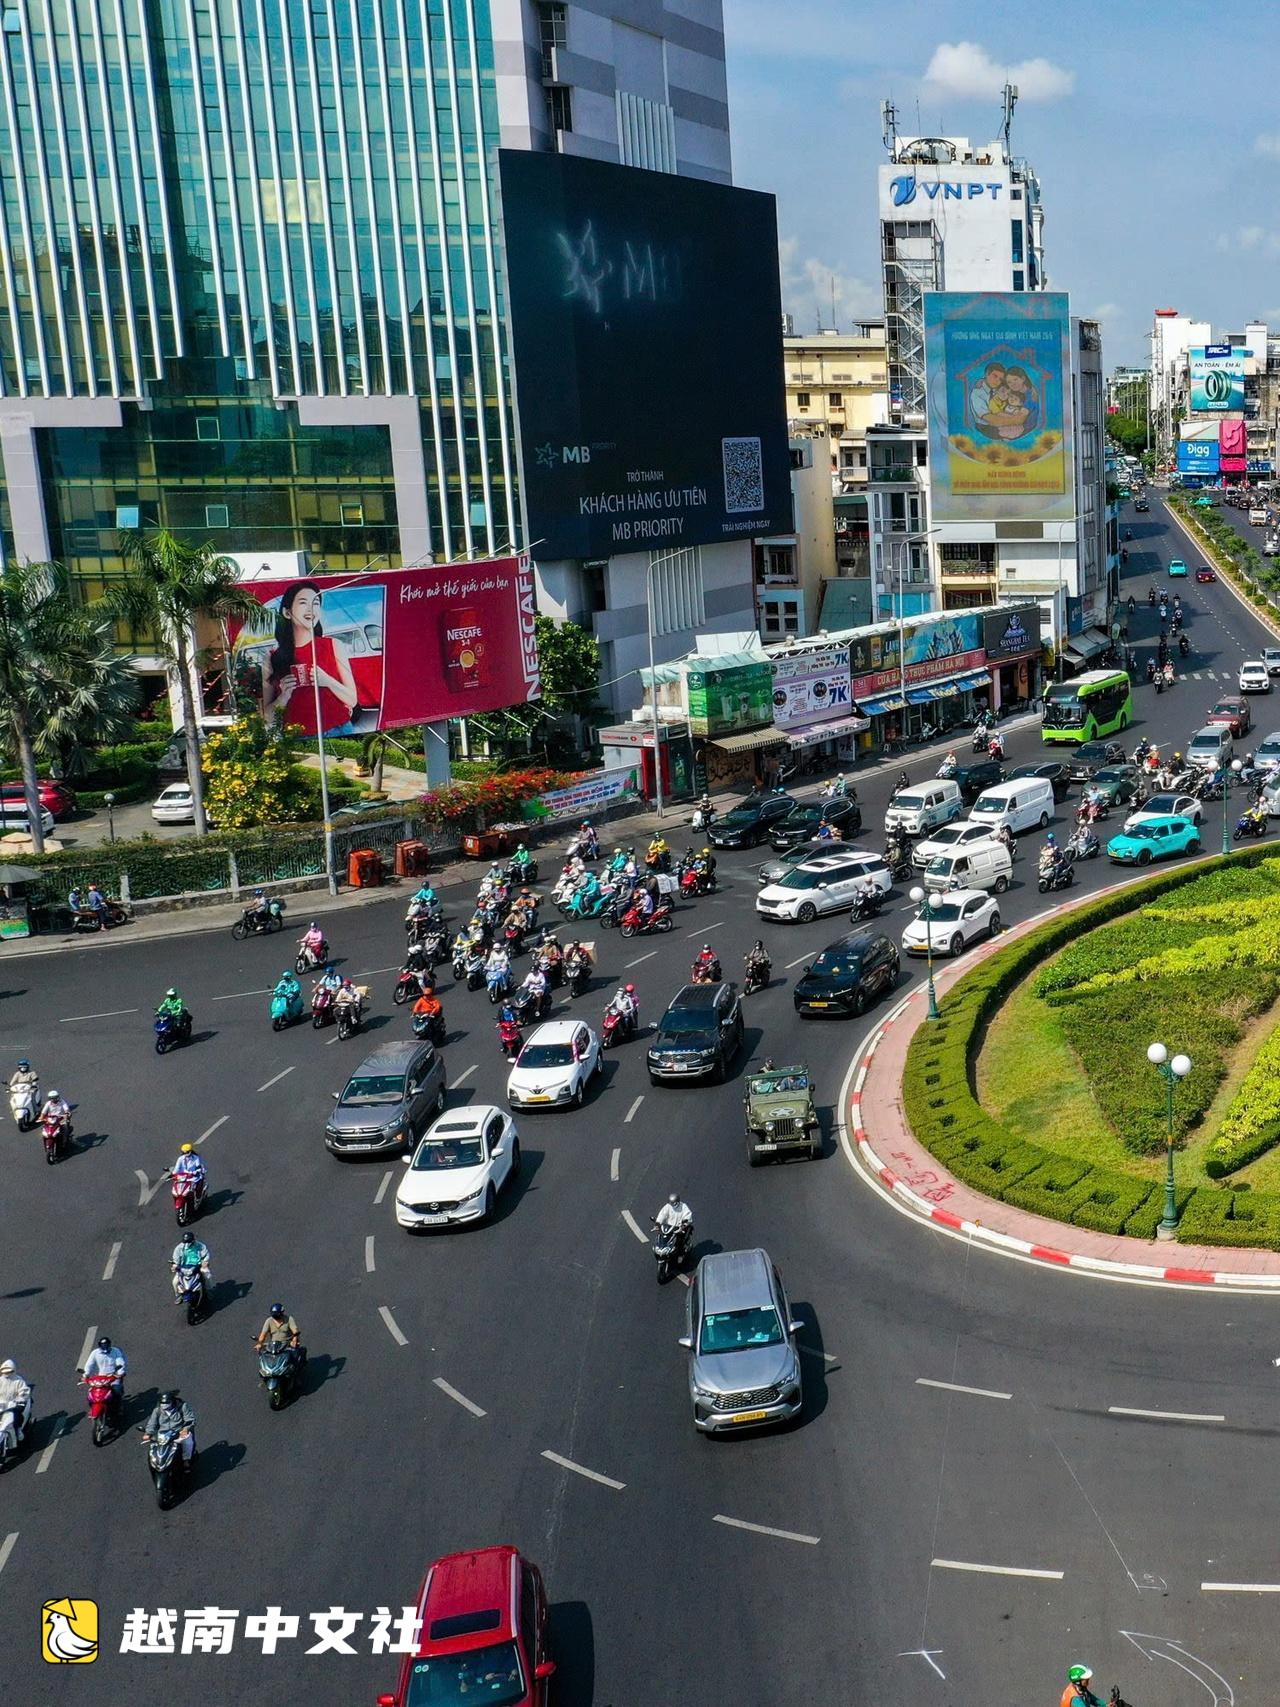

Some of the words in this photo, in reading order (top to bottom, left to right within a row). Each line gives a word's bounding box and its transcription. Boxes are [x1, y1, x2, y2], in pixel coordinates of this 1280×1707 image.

[921, 182, 1003, 200] VNPT
[562, 446, 591, 463] MB
[579, 491, 625, 515] KHÁCH
[626, 489, 662, 512] HÀNG
[684, 486, 707, 506] TIÊN
[612, 522, 631, 541] MB
[633, 517, 684, 538] PRIORITY
[443, 579, 460, 598] thế
[461, 578, 479, 598] giới
[480, 577, 496, 591] của
[828, 685, 848, 703] 7K
